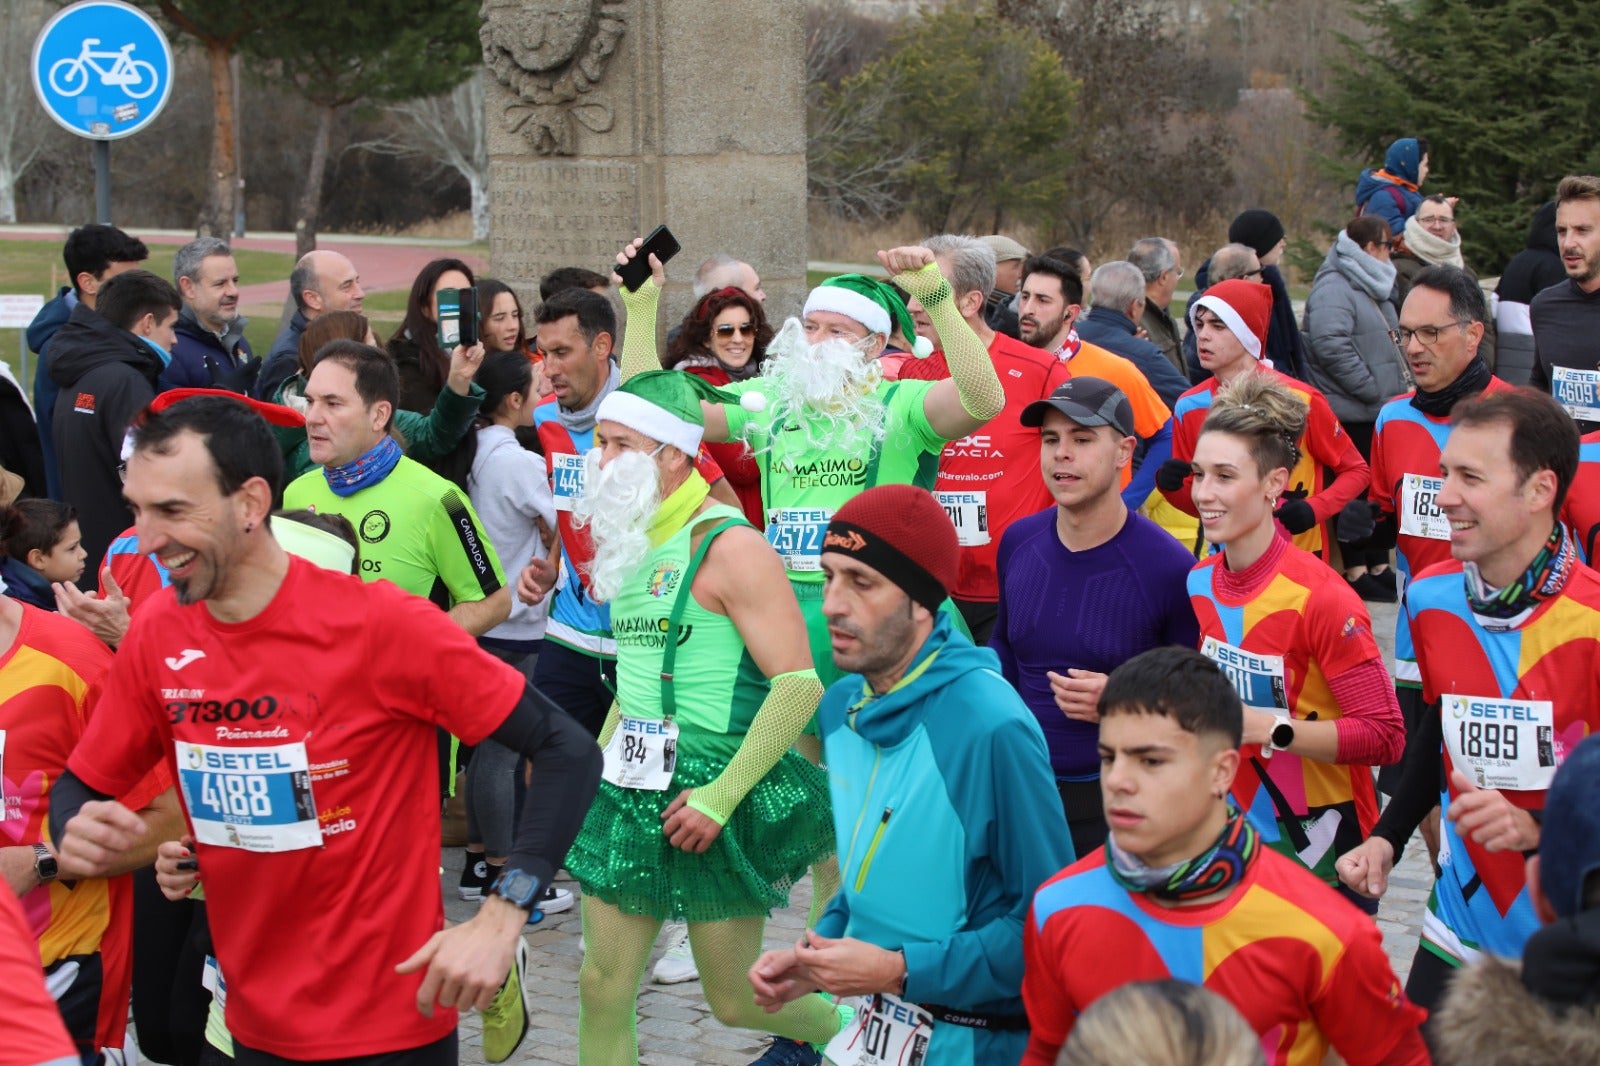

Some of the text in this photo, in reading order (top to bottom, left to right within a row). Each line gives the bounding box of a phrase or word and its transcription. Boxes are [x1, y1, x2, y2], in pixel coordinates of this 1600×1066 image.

[1566, 371, 1599, 383] SETEL
[1559, 381, 1594, 404] 4609
[944, 448, 1004, 458] DACIA
[937, 470, 1004, 481] ultarevalo.com
[939, 494, 979, 504] SETEL
[781, 510, 831, 522] SETEL
[459, 518, 487, 575] CARBAJOSA
[772, 524, 819, 550] 2572
[360, 559, 382, 573] OS
[1218, 646, 1273, 673] SETEL
[1217, 662, 1254, 702] 911
[165, 695, 278, 725] 37300
[1471, 702, 1539, 722] SETEL
[215, 725, 290, 740] Peñaranda
[623, 718, 669, 735] SETEL
[1460, 720, 1518, 760] 1899
[206, 751, 291, 770] SETEL
[201, 772, 273, 817] 4188
[943, 1013, 988, 1027] COMPRI
